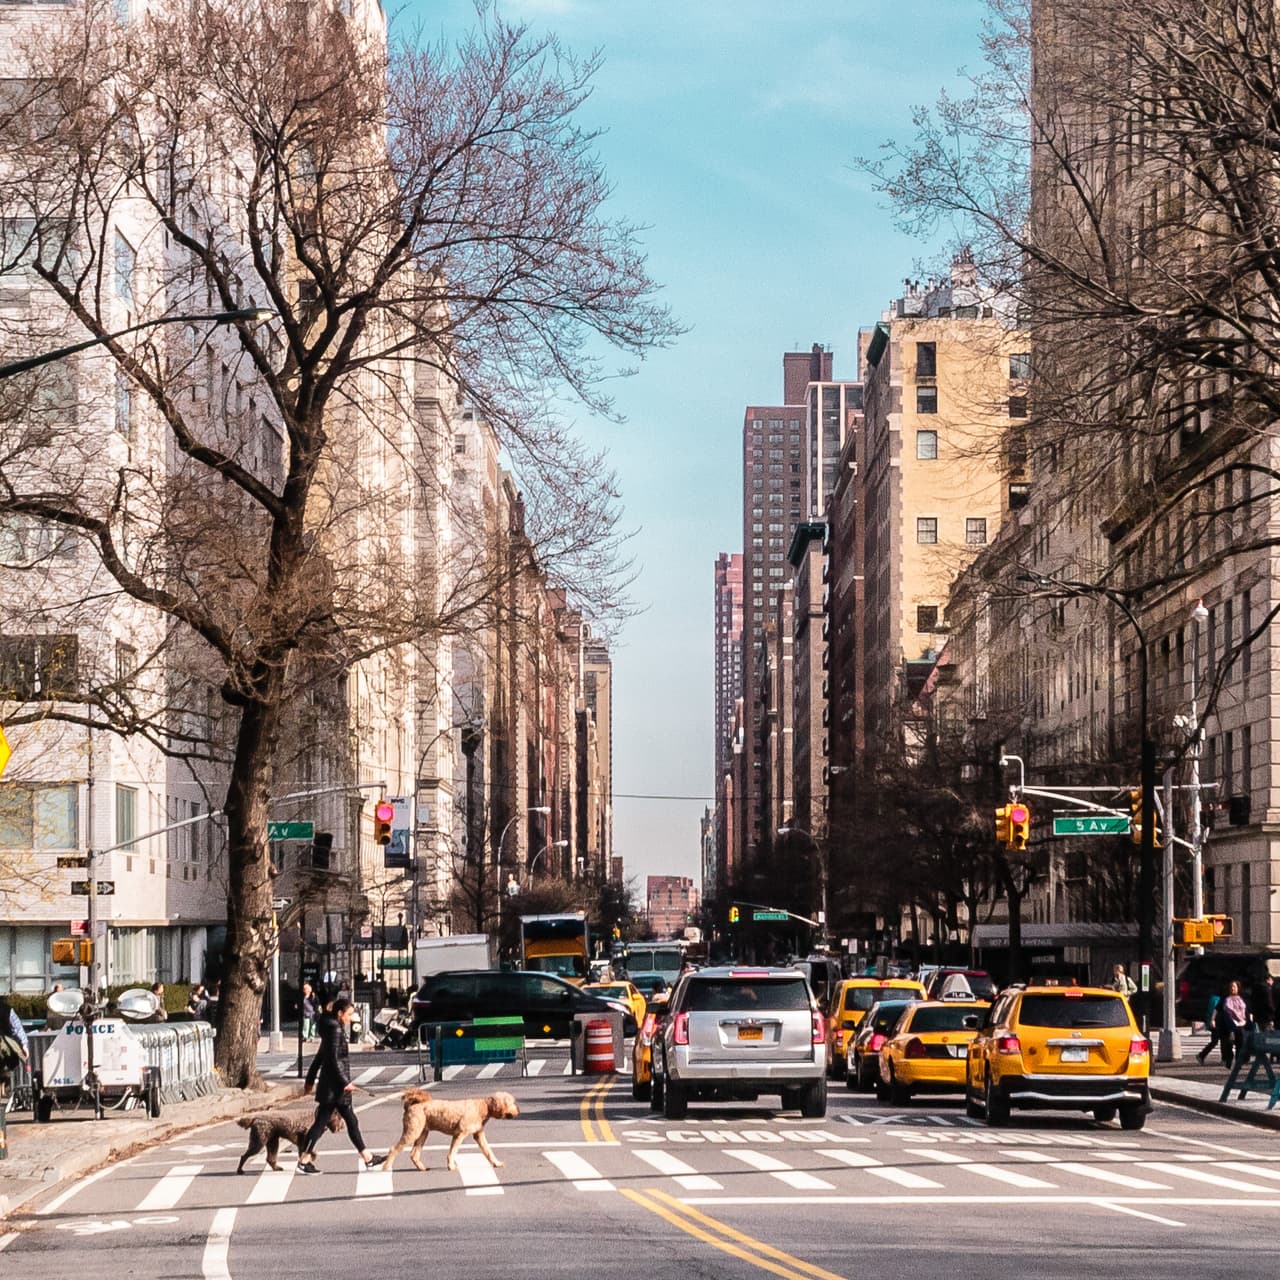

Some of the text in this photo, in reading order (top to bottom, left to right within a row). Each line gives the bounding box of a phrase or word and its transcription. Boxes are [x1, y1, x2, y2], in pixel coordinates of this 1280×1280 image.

[1076, 820, 1107, 831] 5 Av
[66, 1024, 115, 1035] POICE
[621, 1129, 1141, 1147] SCHOOL SCHOOL
